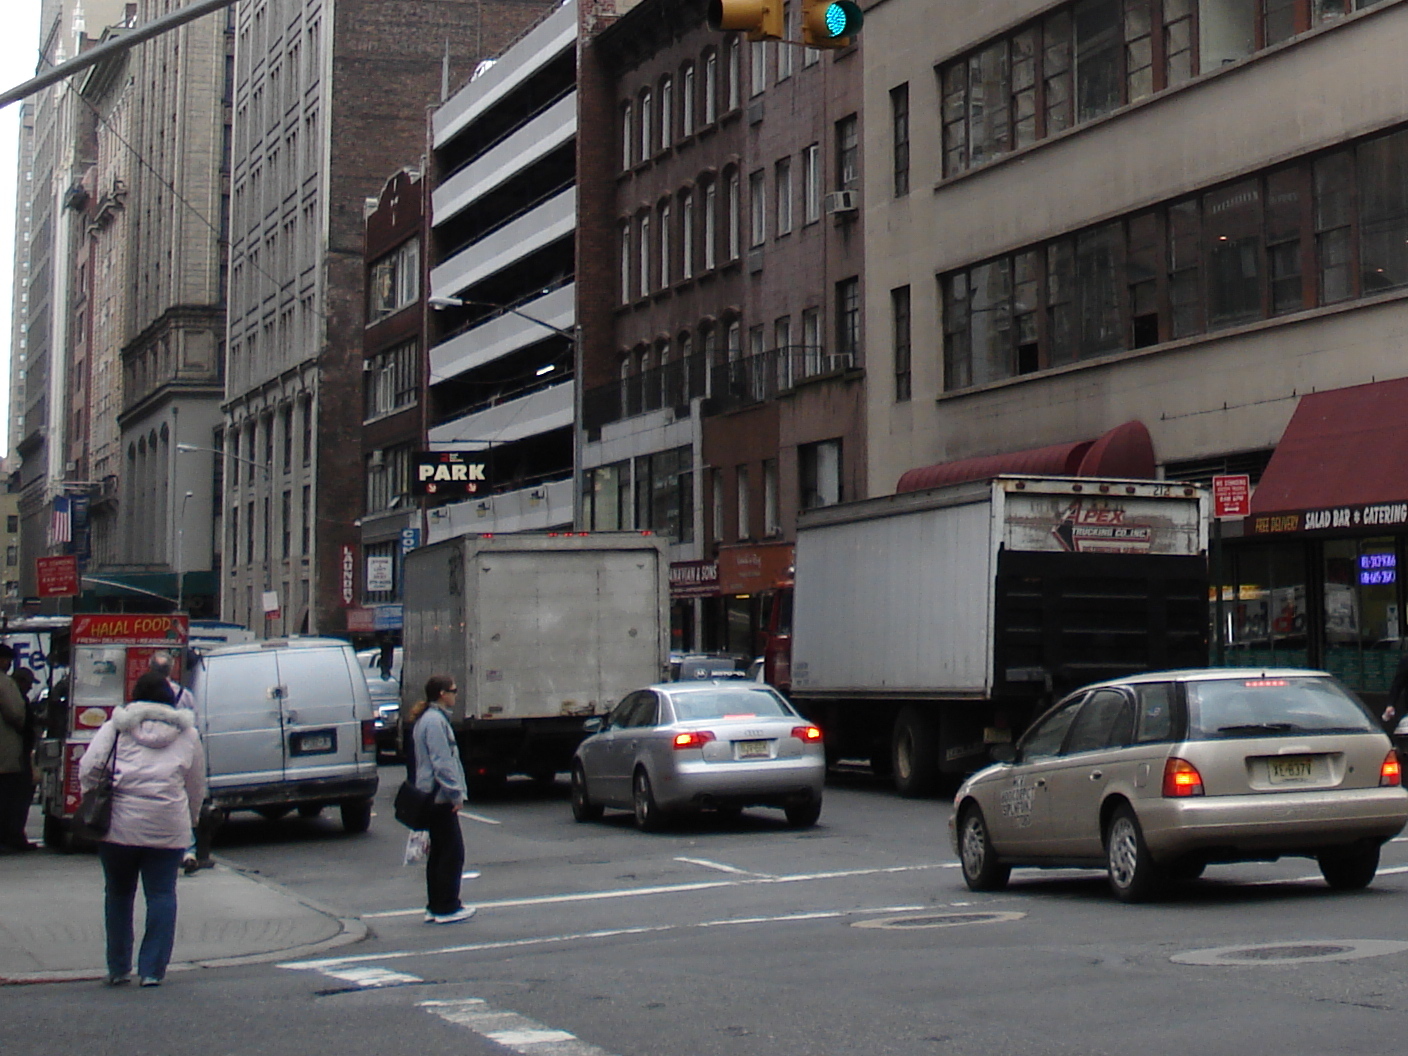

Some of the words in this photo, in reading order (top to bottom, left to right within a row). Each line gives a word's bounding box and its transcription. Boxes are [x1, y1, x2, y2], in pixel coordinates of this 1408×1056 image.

[418, 464, 486, 481] PARK
[1061, 498, 1126, 524] APEX
[1304, 511, 1330, 530] SALAD
[1333, 508, 1350, 527] BAR
[1363, 504, 1408, 524] CATERING
[1072, 527, 1113, 537] TRUCKING
[1255, 517, 1269, 533] FREE
[1270, 515, 1299, 532] DELIVERY
[342, 545, 353, 604] LAUNDRY
[701, 564, 718, 581] SONS
[90, 620, 129, 636] HALAL
[134, 617, 172, 634] FOOD
